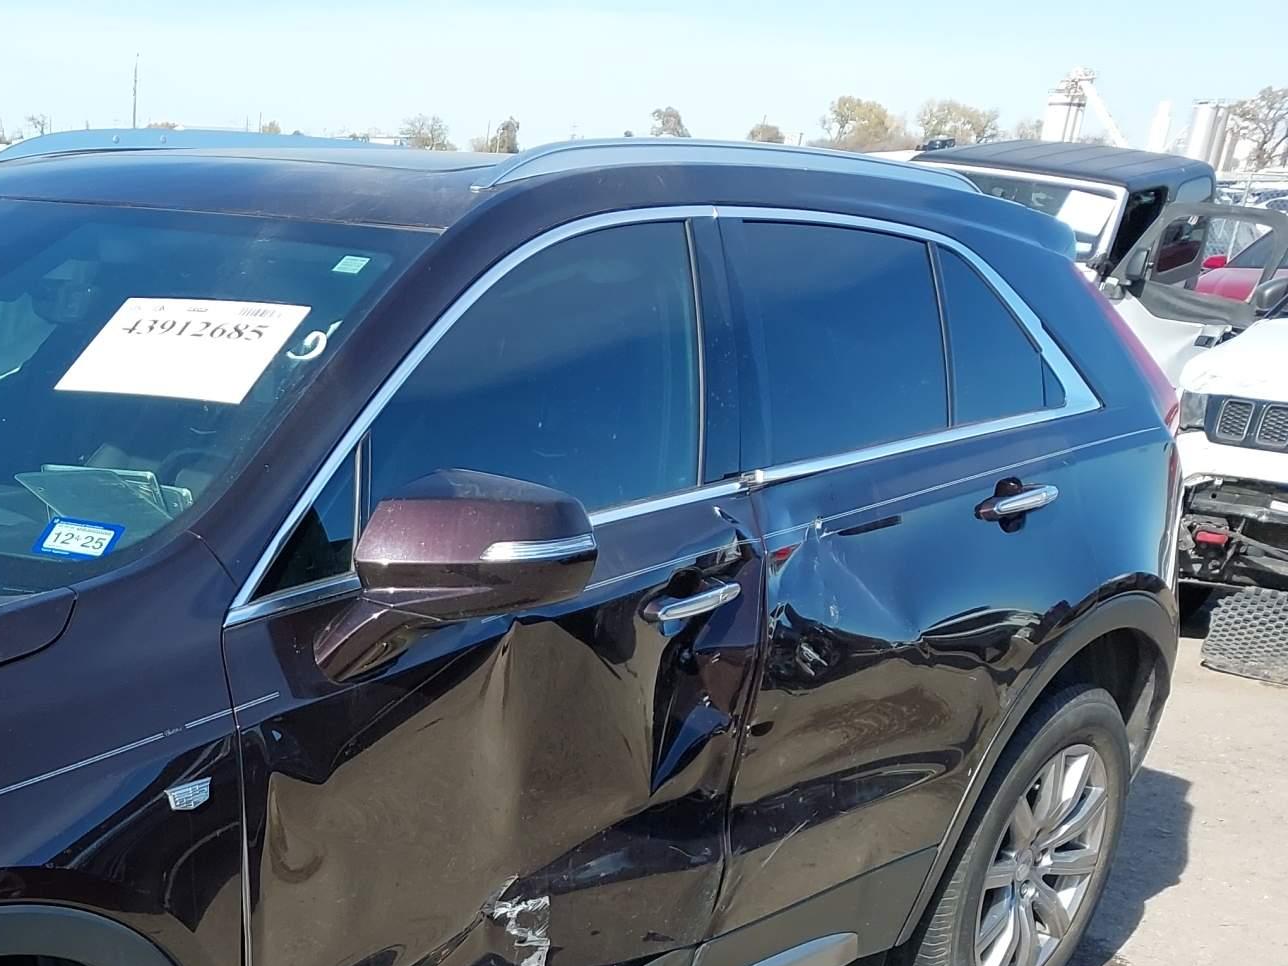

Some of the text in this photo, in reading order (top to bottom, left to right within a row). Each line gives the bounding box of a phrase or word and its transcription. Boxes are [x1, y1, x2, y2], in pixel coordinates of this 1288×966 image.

[122, 318, 270, 342] 43912685
[53, 531, 107, 550] 12 25
